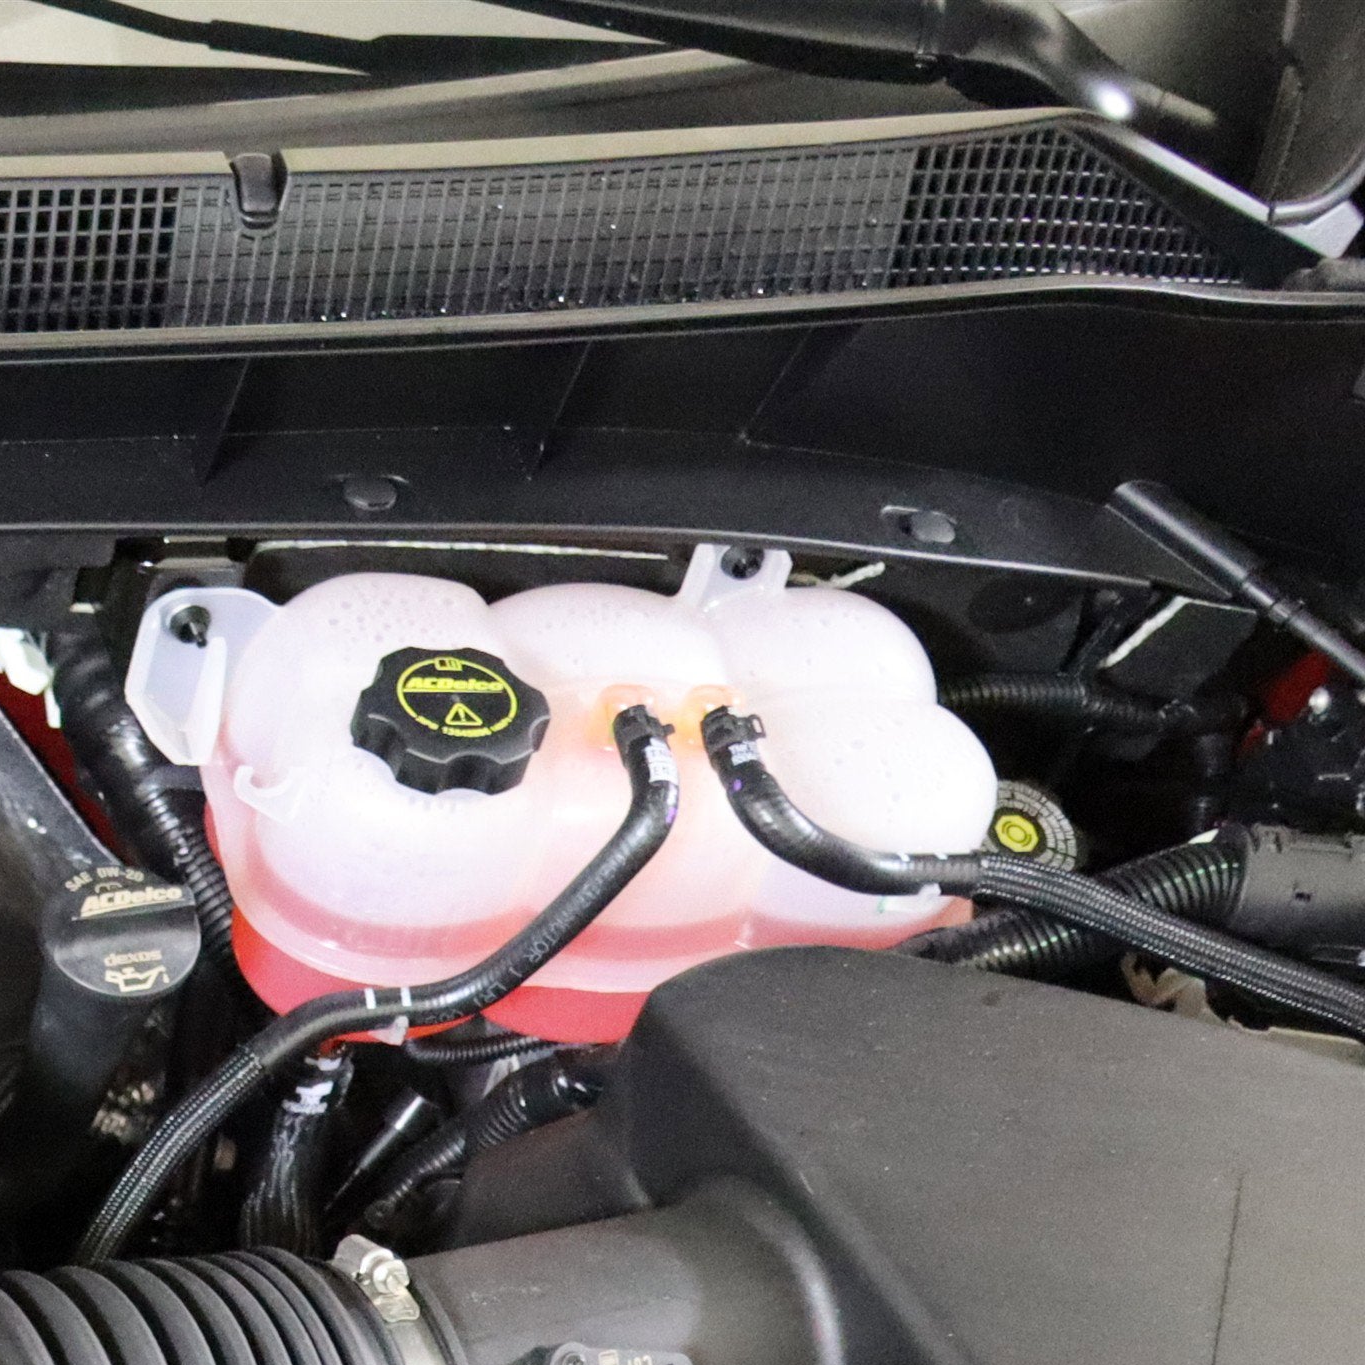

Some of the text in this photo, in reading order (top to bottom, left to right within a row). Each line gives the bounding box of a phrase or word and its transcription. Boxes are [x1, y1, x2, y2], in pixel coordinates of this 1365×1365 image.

[404, 677, 505, 692] ACDelco
[65, 866, 145, 892] SAE 0W-20
[81, 886, 183, 912] ACDelco
[104, 950, 163, 967] dexos
